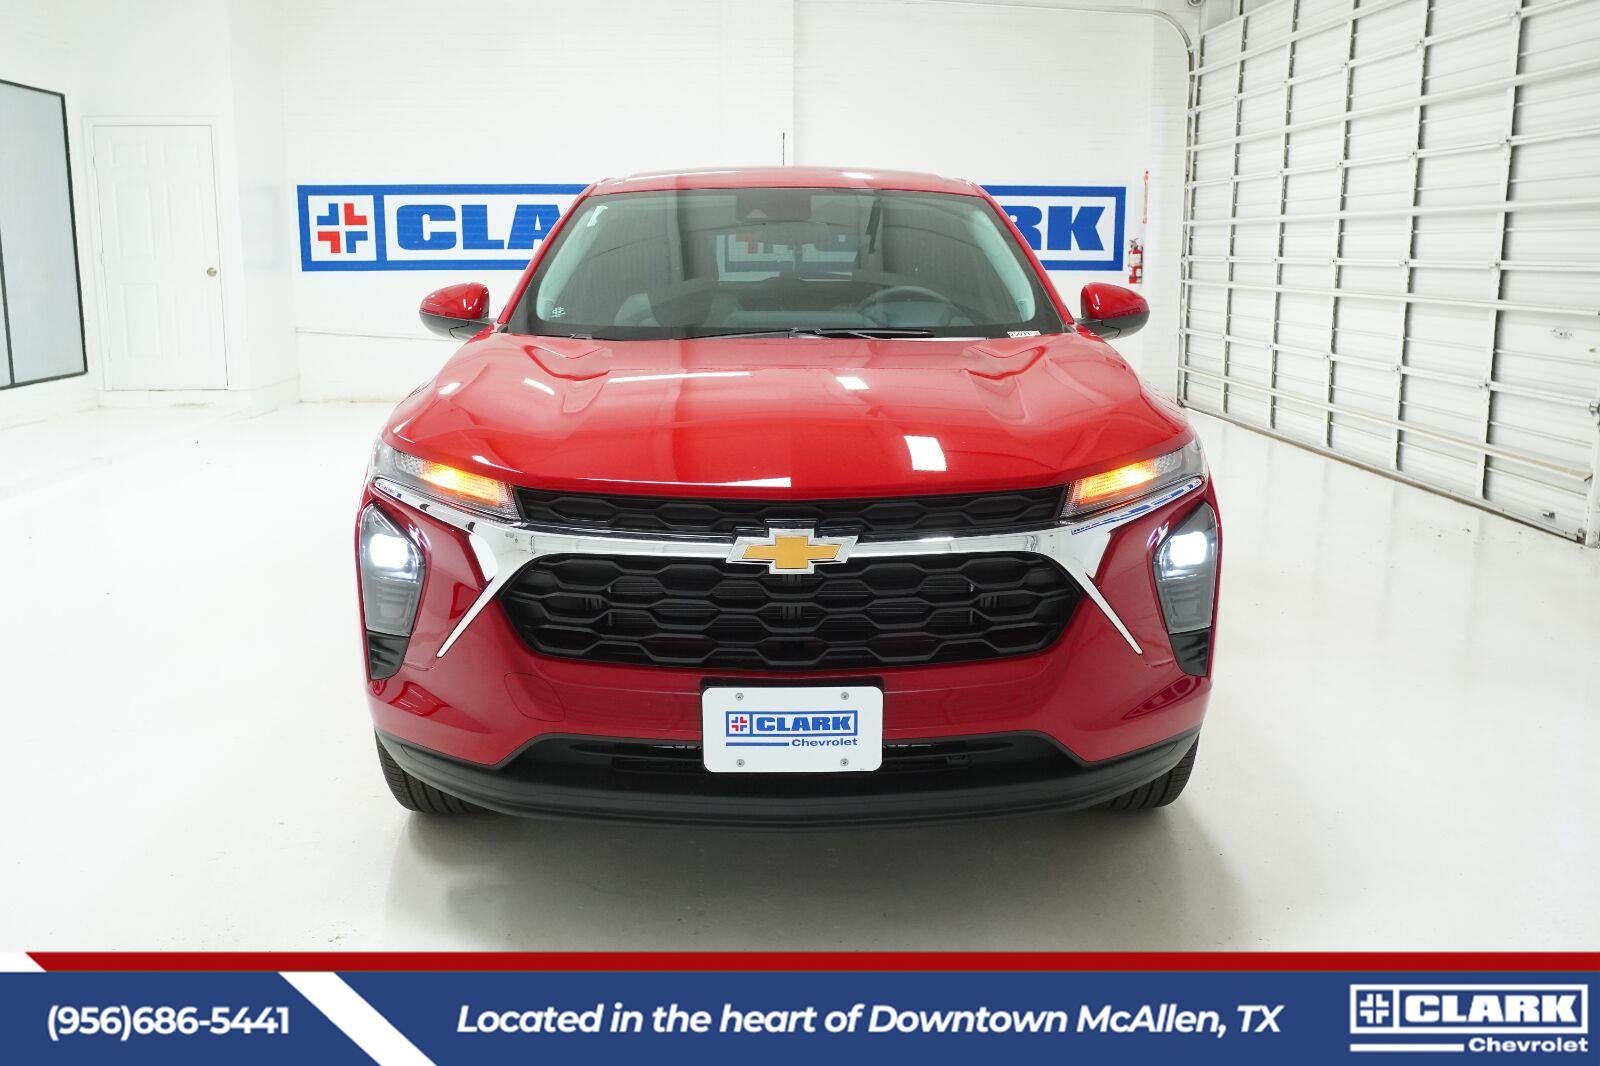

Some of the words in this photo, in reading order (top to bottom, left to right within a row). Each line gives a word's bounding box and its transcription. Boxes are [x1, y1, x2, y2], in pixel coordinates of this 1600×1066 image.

[396, 204, 560, 251] CLA
[756, 716, 851, 731] CLARK
[791, 737, 858, 747] Chevrolet
